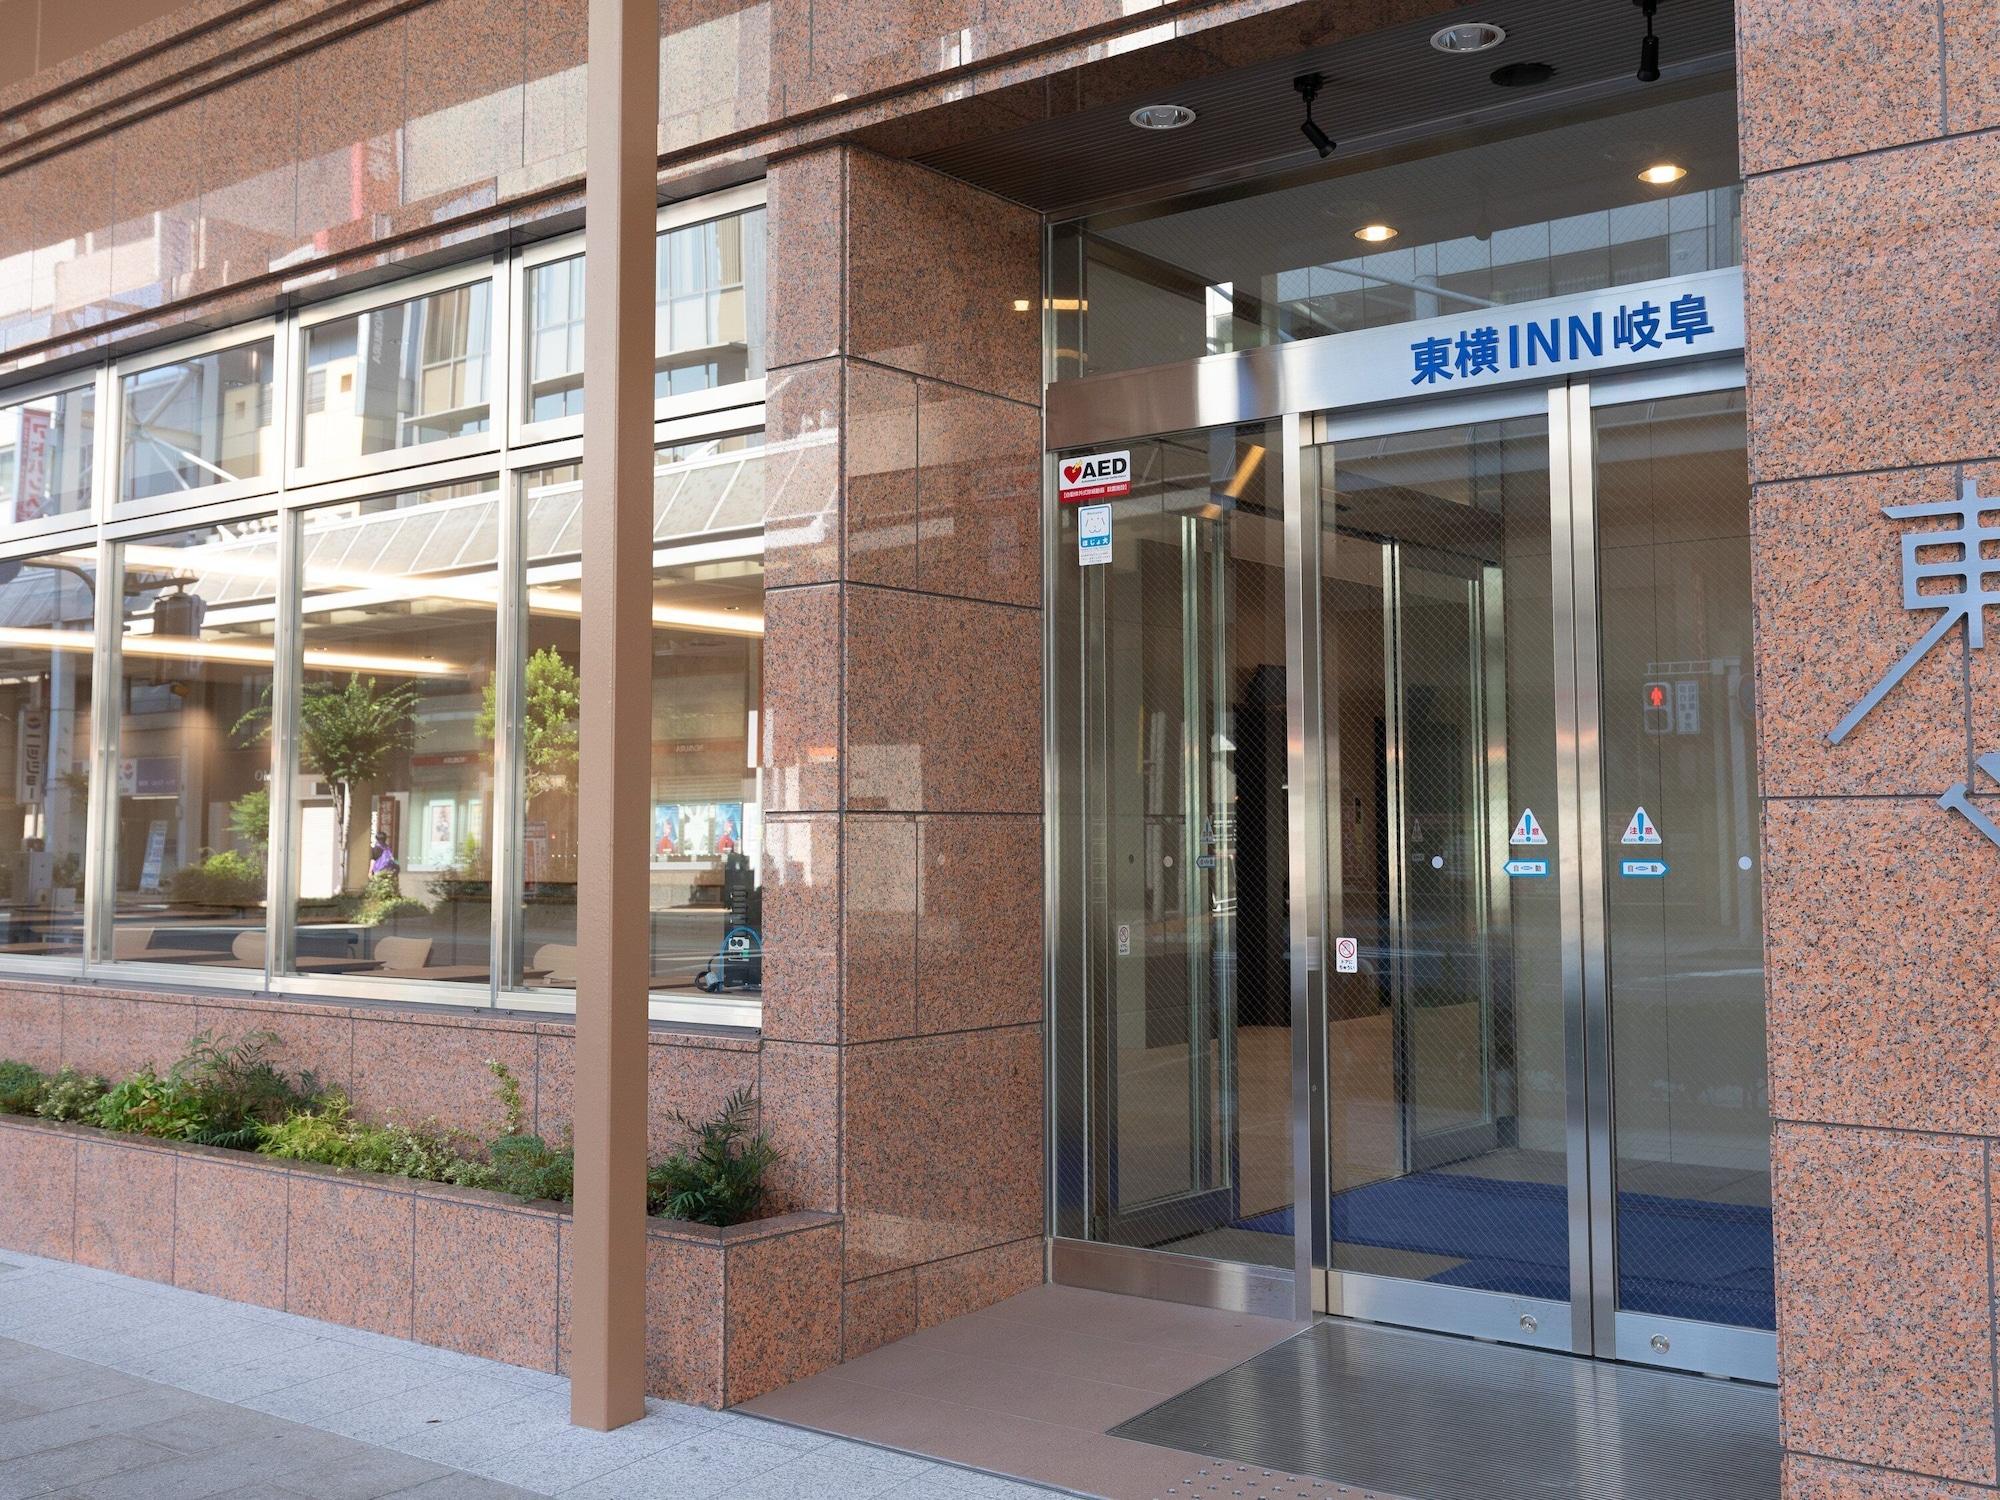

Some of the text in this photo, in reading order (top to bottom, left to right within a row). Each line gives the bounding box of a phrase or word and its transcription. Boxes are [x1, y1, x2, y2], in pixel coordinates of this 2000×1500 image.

[1410, 293, 1715, 386] 東横INN岐阜
[1082, 458, 1127, 479] AED
[1517, 827, 1540, 836] 注意
[1630, 826, 1653, 835] 注意
